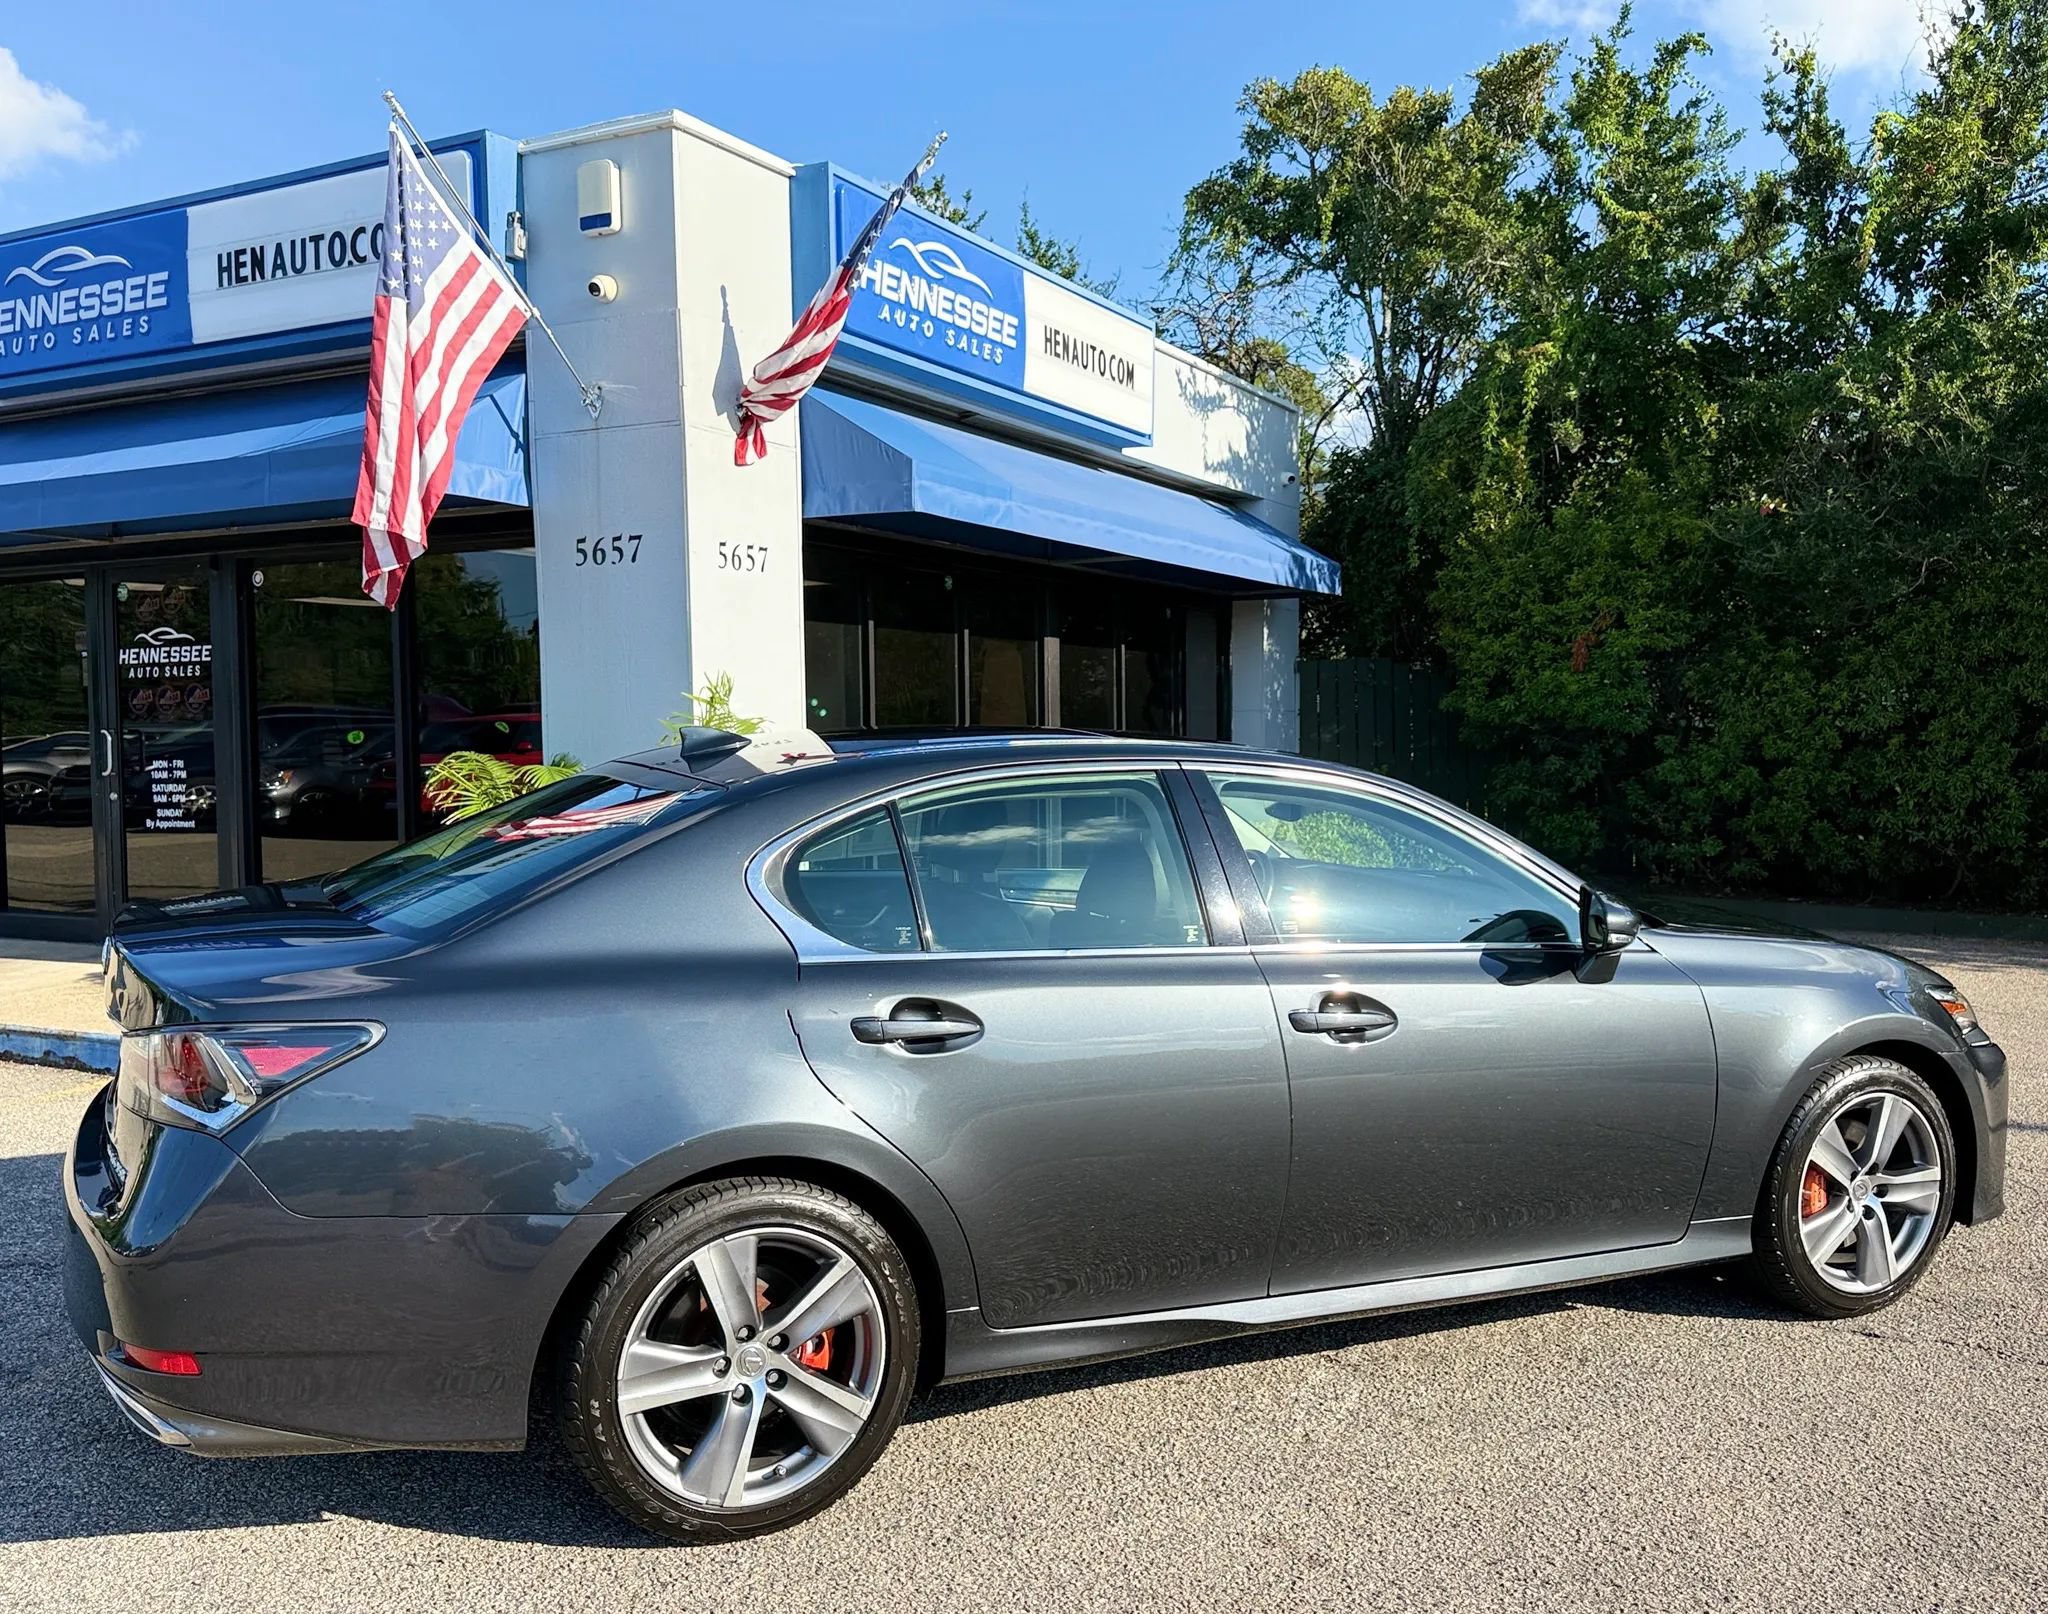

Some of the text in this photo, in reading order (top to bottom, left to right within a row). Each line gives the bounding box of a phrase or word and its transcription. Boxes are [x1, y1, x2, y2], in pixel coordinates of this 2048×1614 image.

[217, 222, 384, 288] HENAUTO.CO
[0, 271, 169, 335] ENNESSEE
[861, 258, 1018, 348] HENNESSEE
[72, 315, 149, 344] SALES
[877, 303, 1004, 365] AUTO SALES
[575, 533, 643, 567] 5657
[717, 541, 768, 572] 5657
[118, 645, 213, 665] HENNESSEE
[128, 665, 201, 679] AUTO SALES
[151, 770, 169, 779] 10AM
[173, 770, 187, 779] 7PM
[152, 760, 168, 769] MON
[173, 760, 184, 768] FRI
[151, 783, 187, 793] SATURDAY
[145, 819, 196, 830] By Appointment
[156, 808, 184, 818] SUNDAY
